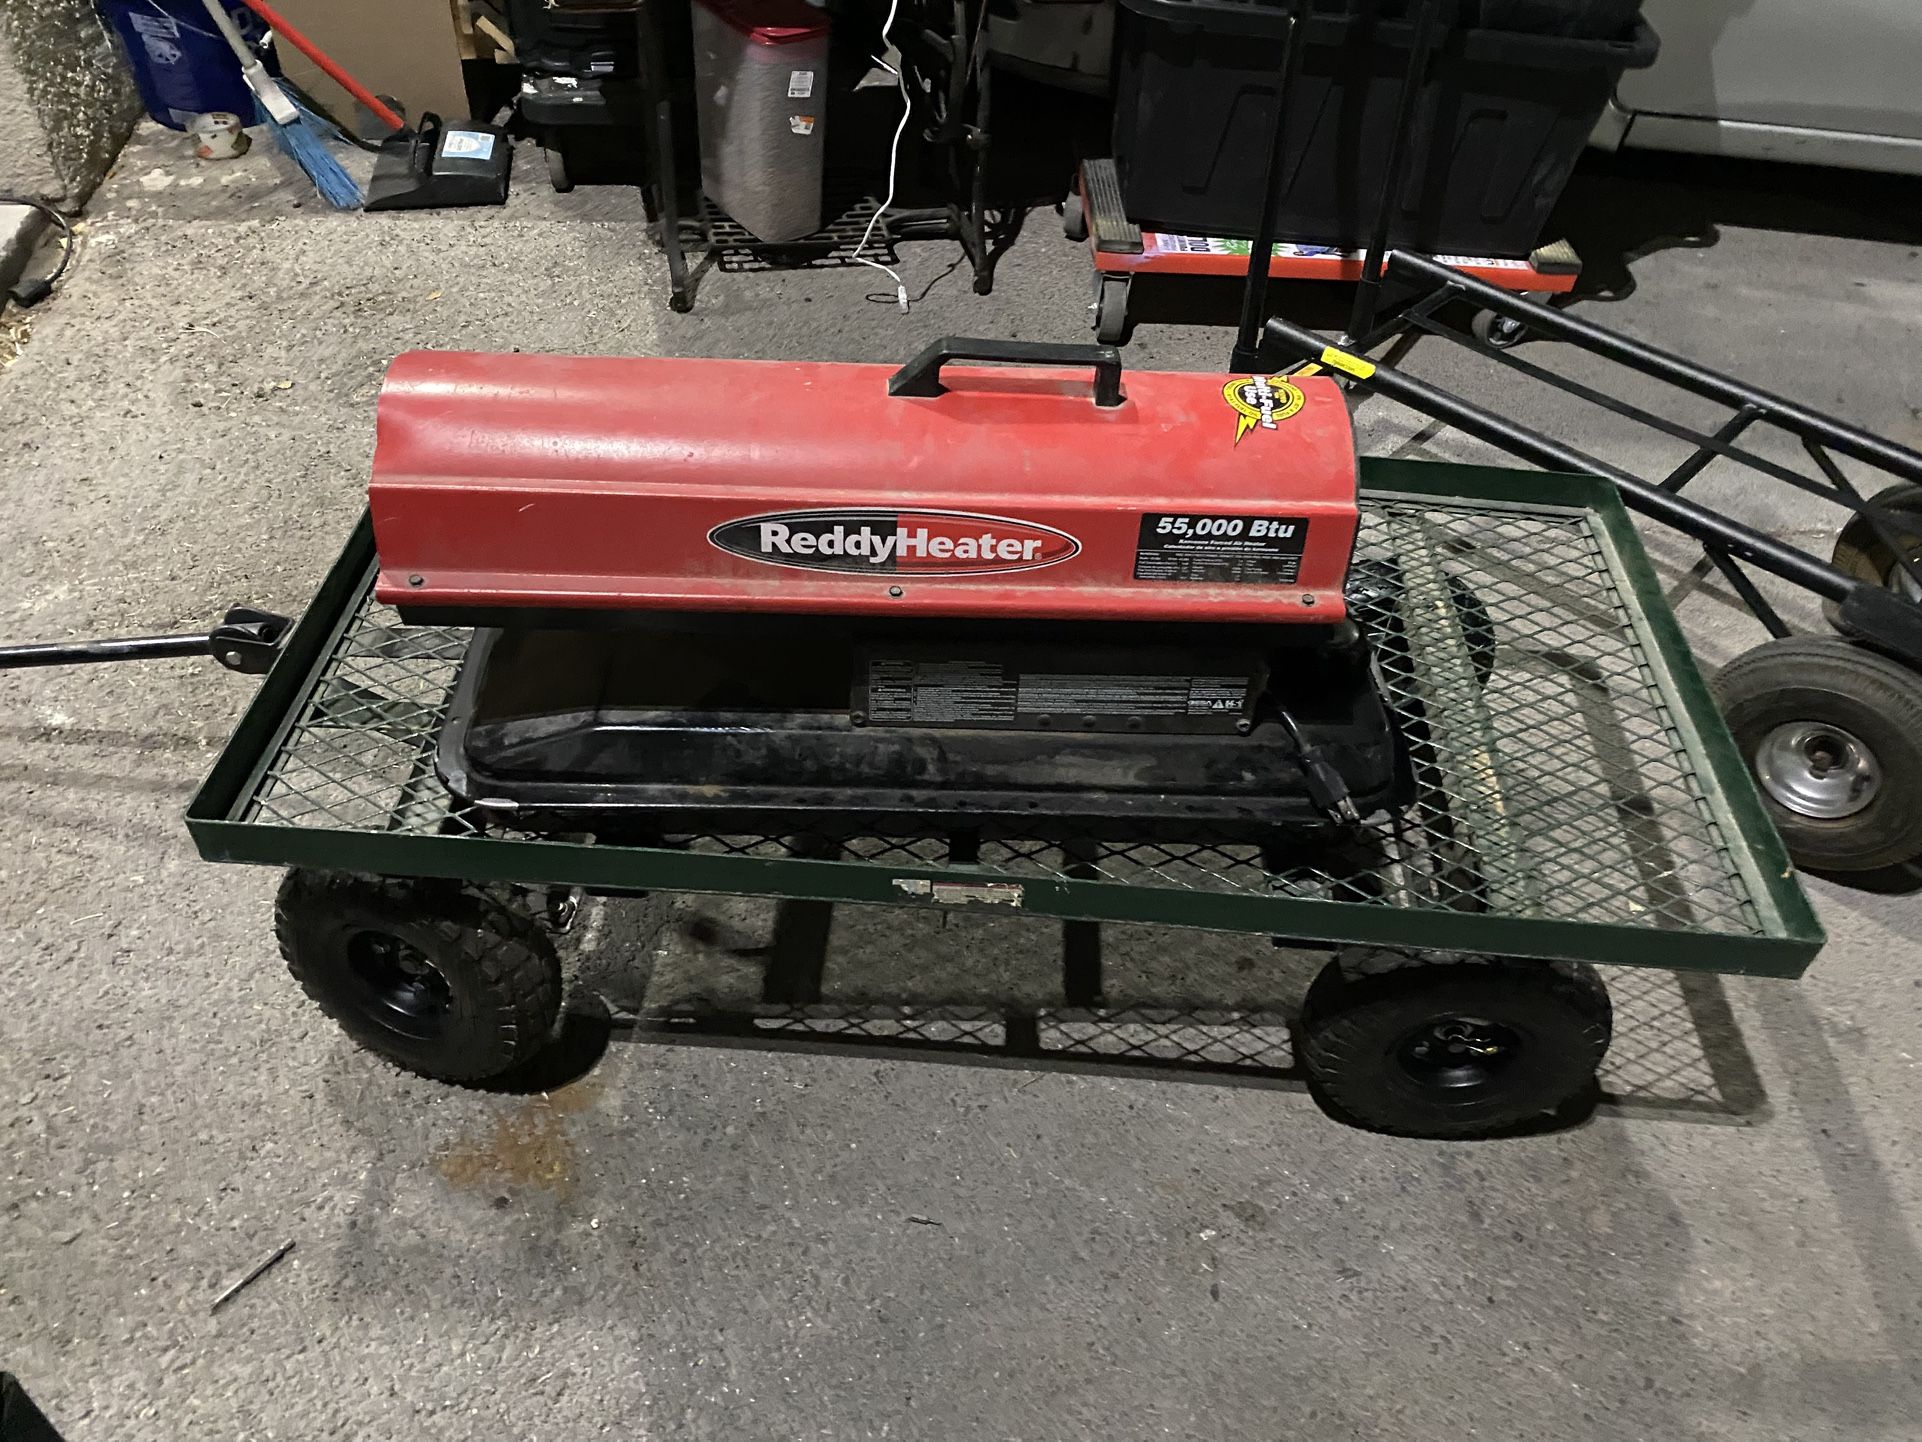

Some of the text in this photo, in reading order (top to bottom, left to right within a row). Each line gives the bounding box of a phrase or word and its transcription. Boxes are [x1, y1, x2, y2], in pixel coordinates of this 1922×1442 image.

[1243, 385, 1258, 404] Use
[1156, 517, 1295, 538] 55,000 Btu
[760, 523, 1041, 563] ReddyHeater
